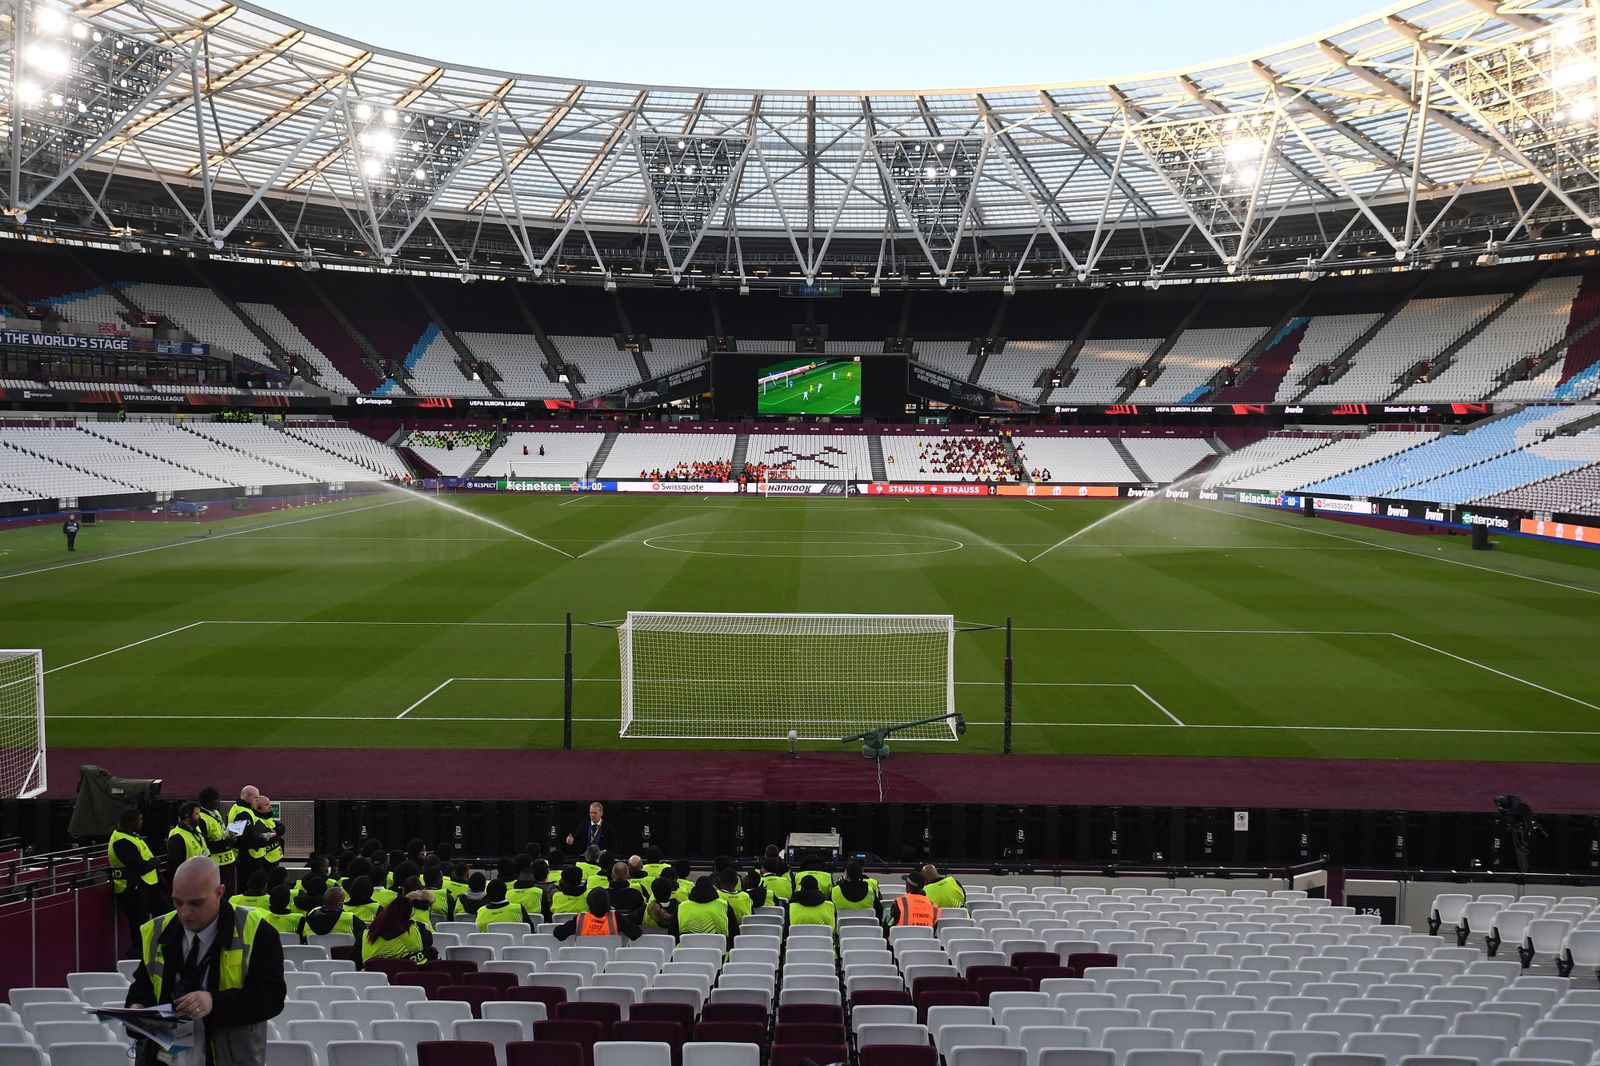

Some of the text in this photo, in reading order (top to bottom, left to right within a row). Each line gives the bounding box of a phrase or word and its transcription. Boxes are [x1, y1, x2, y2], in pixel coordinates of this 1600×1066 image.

[4, 332, 29, 345] THE
[31, 335, 88, 348] WORLD'S
[89, 338, 128, 350] STAGE
[362, 397, 392, 405] Swissquote
[506, 481, 561, 491] Heineken
[661, 483, 704, 493] Swissquote
[943, 486, 980, 494] STRAUSS
[1127, 487, 1154, 497] bwin
[1165, 489, 1189, 498] bwin
[1199, 490, 1218, 500] bwin
[1239, 492, 1276, 506] Heineken
[1323, 499, 1353, 510] Swissquote
[1387, 504, 1409, 518] bwin
[1425, 508, 1444, 522] bwin
[1463, 512, 1509, 529] enterprise
[1361, 908, 1380, 916] 124
